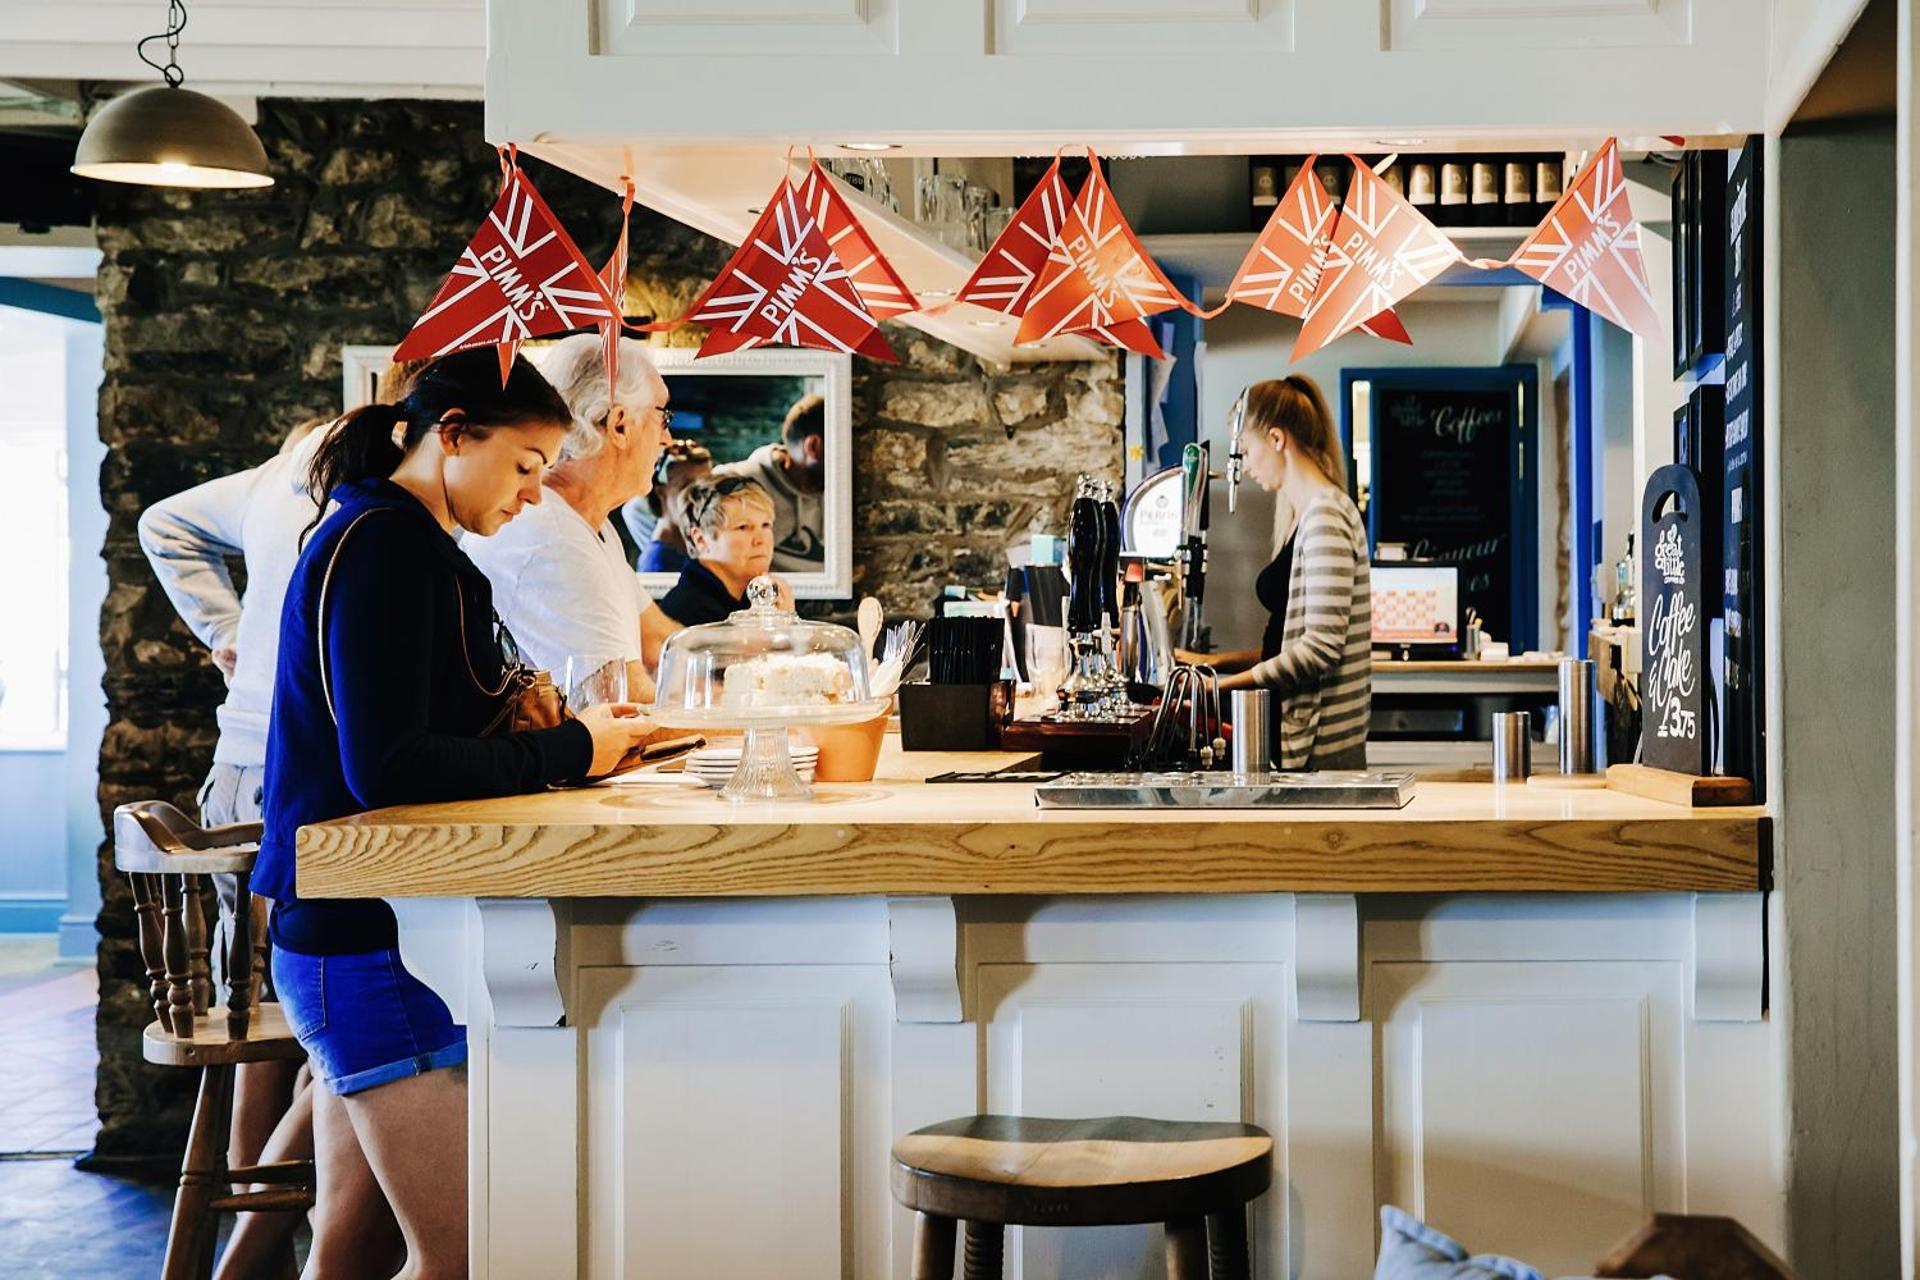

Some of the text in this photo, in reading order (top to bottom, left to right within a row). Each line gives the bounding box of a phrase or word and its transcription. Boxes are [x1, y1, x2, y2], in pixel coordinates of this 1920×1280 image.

[479, 244, 547, 321] PIMM'S
[1563, 209, 1621, 284] PIMM'S
[759, 247, 822, 327] PIMM'S
[1648, 590, 1696, 657] Coffee
[1656, 638, 1695, 708] Cake
